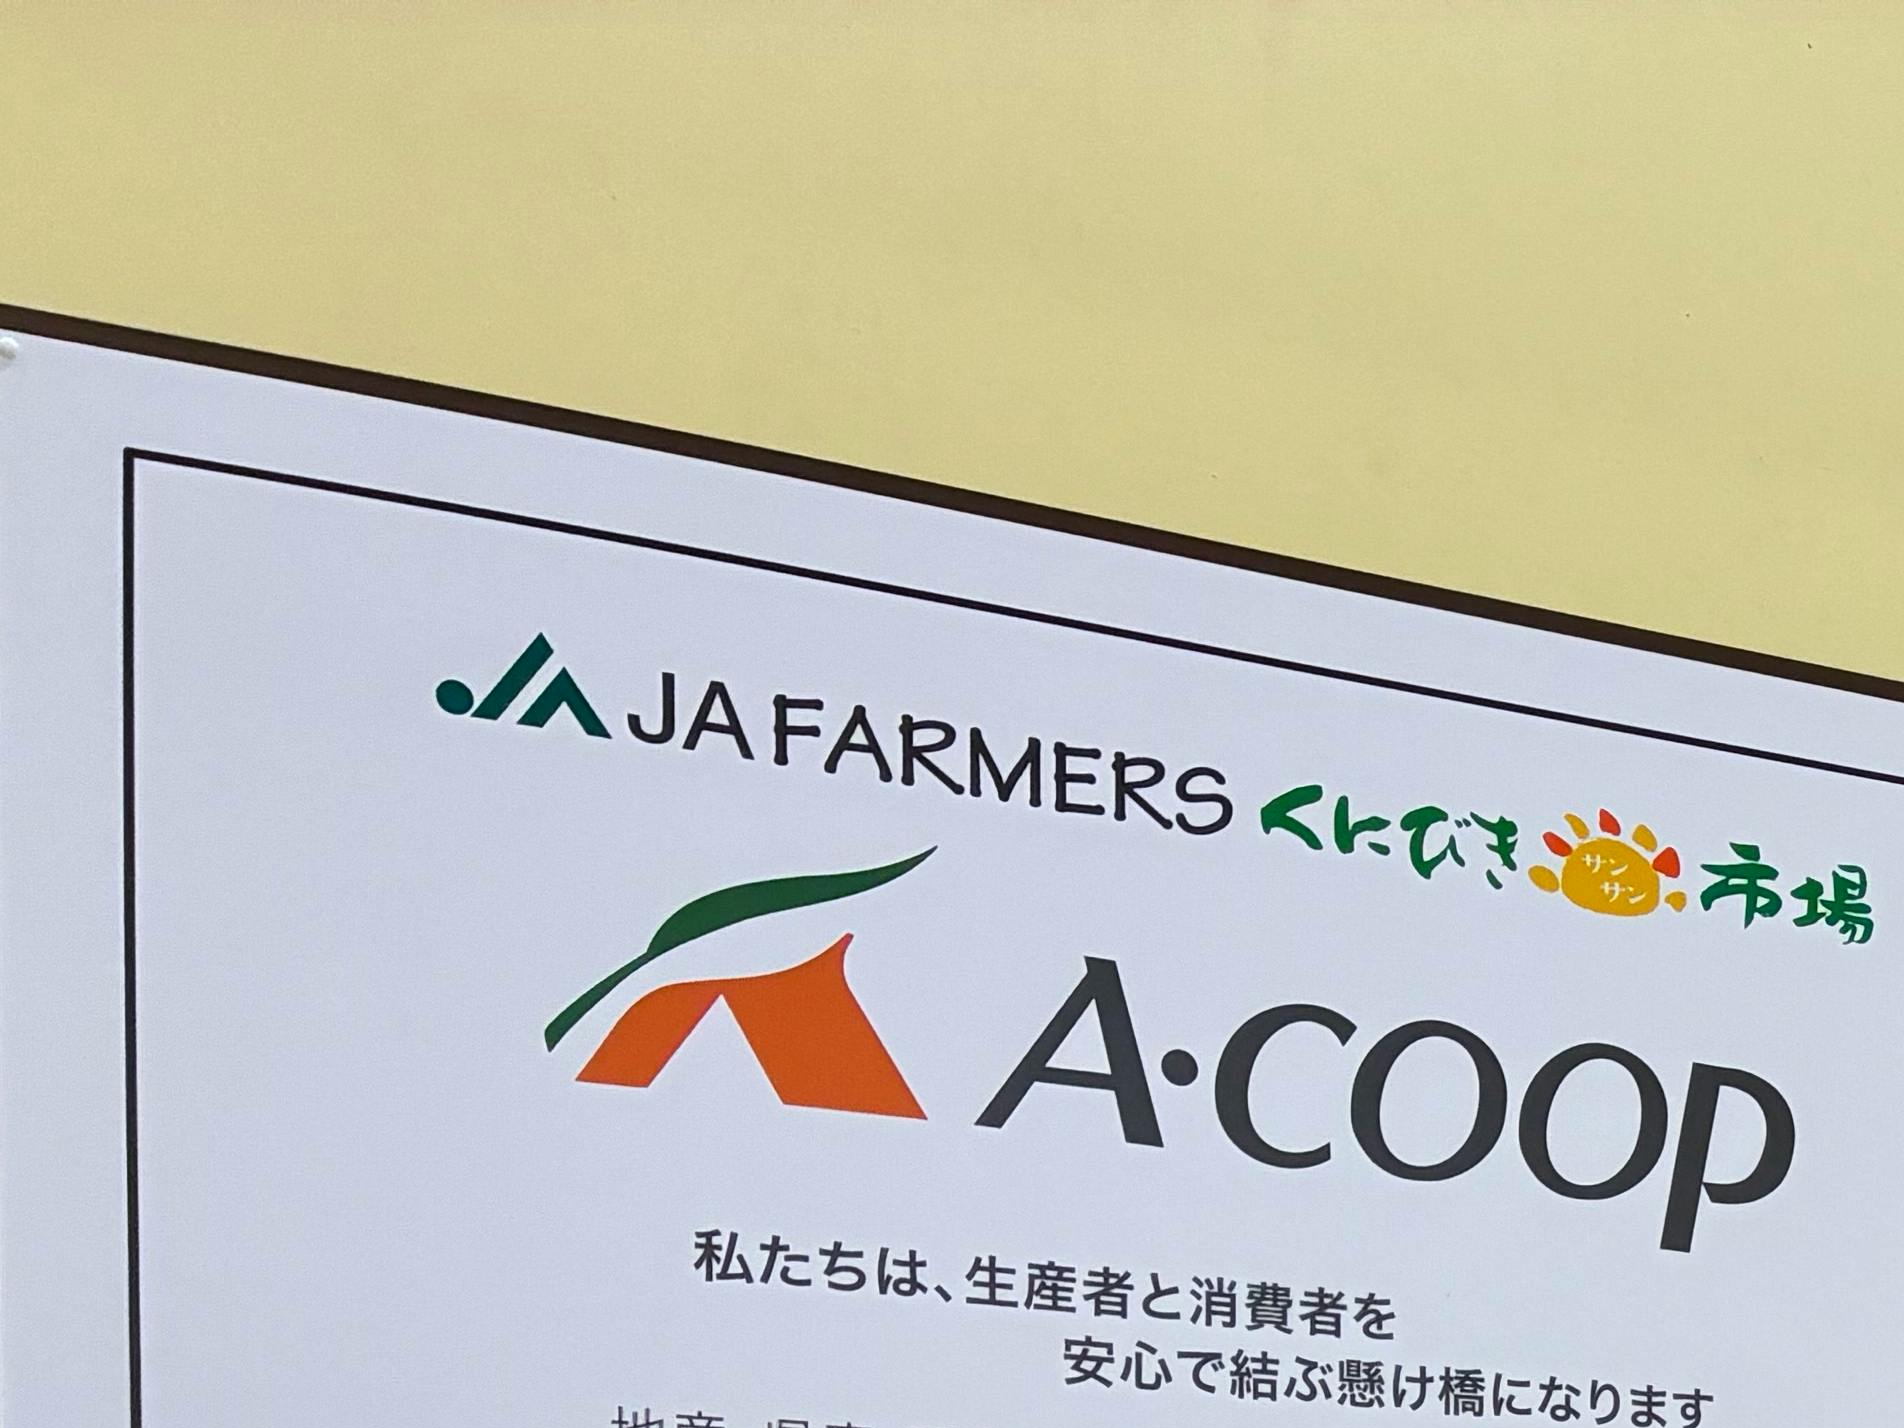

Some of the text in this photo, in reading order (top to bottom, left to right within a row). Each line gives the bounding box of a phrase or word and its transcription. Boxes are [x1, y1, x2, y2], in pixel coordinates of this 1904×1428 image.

[1258, 784, 1523, 891] くにびき
[1698, 841, 1876, 946] 市場
[691, 1227, 1398, 1342] 私たちは、生産者と消費者を
